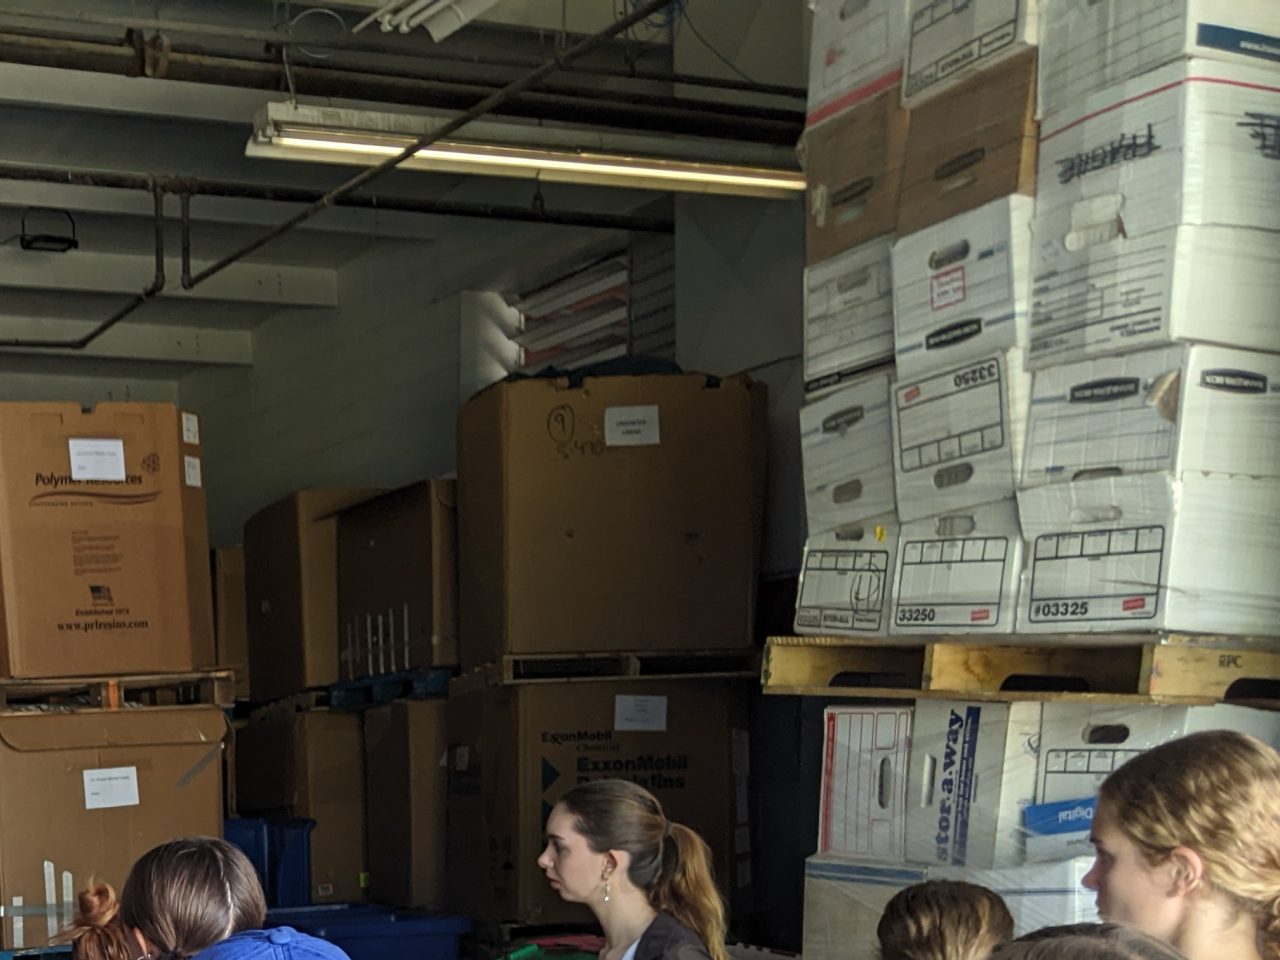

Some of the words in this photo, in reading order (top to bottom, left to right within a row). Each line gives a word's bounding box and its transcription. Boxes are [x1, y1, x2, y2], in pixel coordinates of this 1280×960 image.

[954, 364, 996, 387] 33250
[898, 608, 936, 622] 33250
[1058, 806, 1093, 823] Digital
